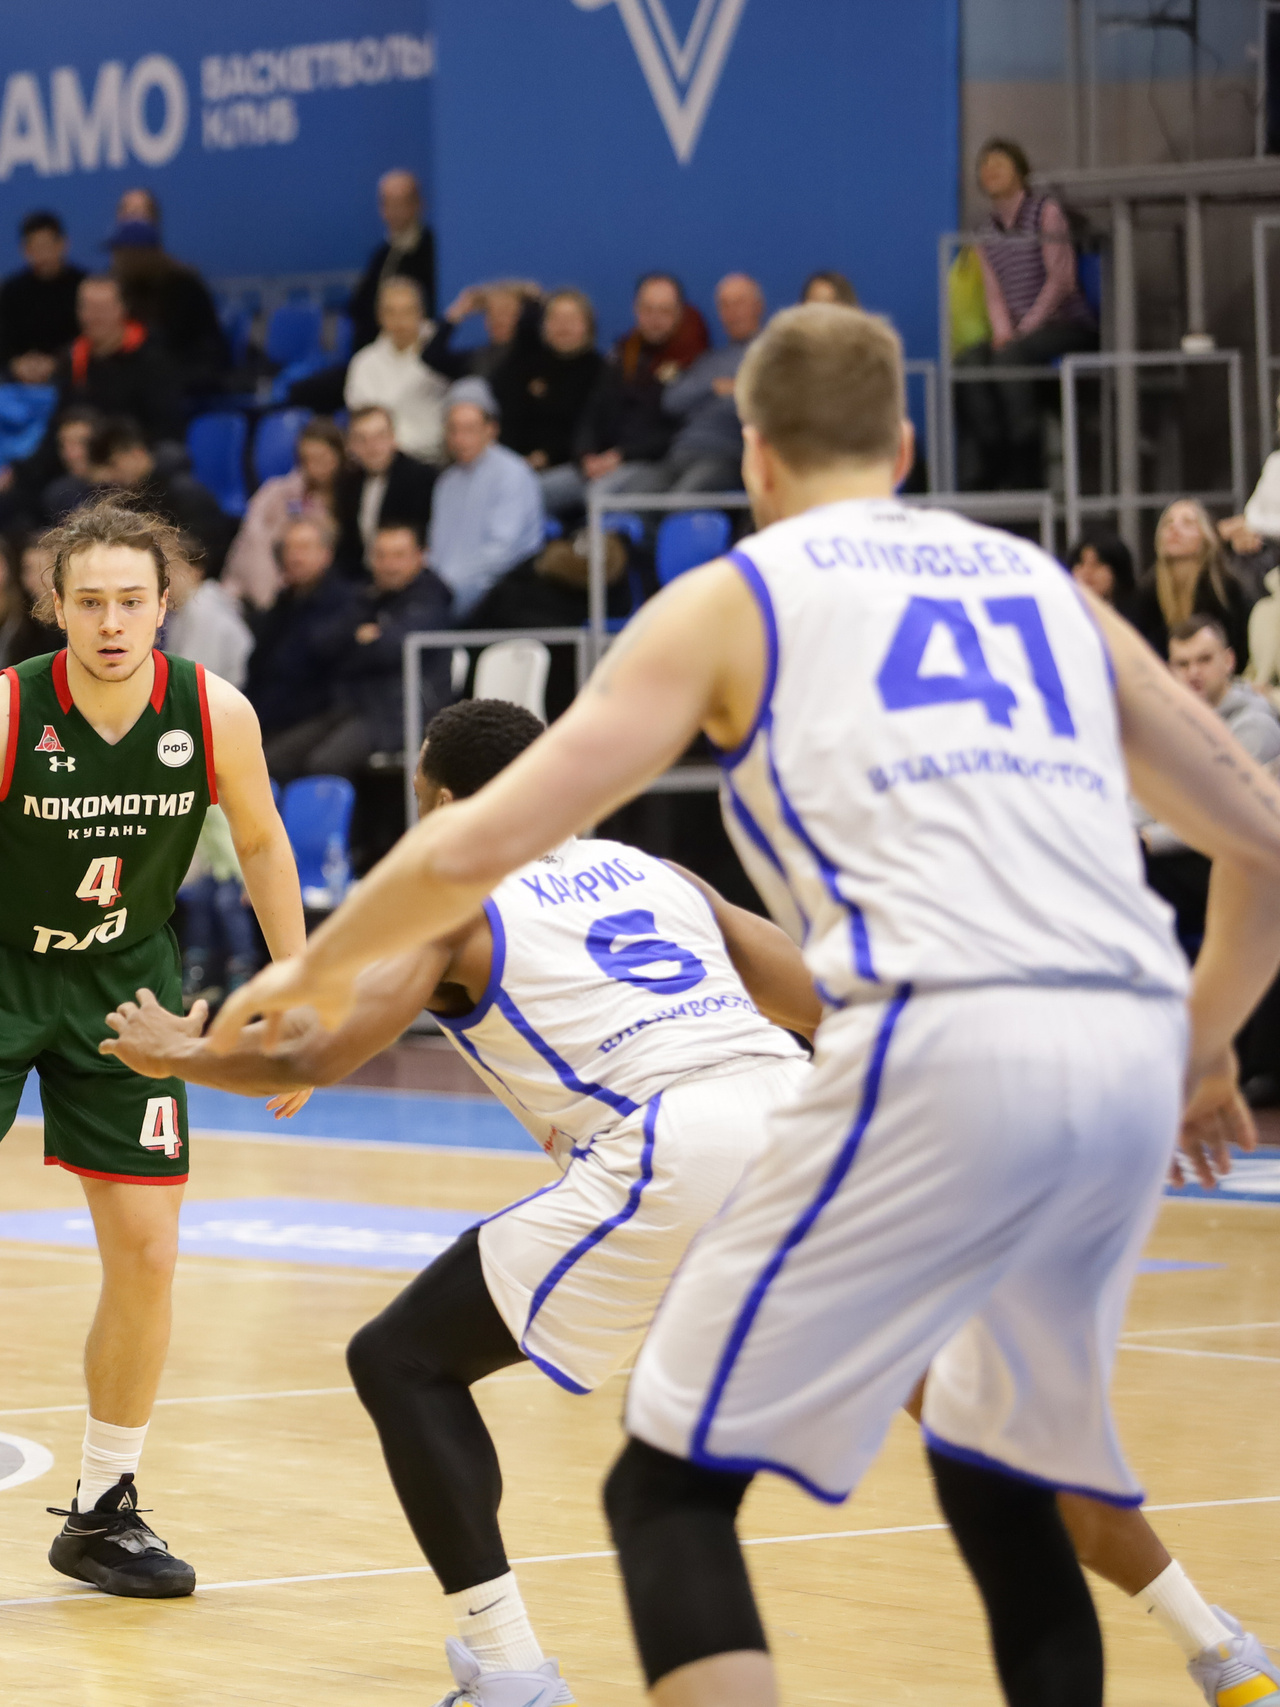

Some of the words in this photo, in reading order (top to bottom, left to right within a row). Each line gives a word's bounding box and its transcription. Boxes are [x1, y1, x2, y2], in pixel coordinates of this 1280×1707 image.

[804, 536, 1033, 577] СОЛОВЬЕВ
[876, 595, 1077, 740] 41
[162, 742, 188, 754] РФБ
[23, 791, 195, 820] ЛОКОМОТИВ
[68, 824, 147, 840] КУБАНЬ
[75, 856, 123, 907] 4
[585, 909, 708, 995] 6
[138, 1096, 183, 1160] 4
